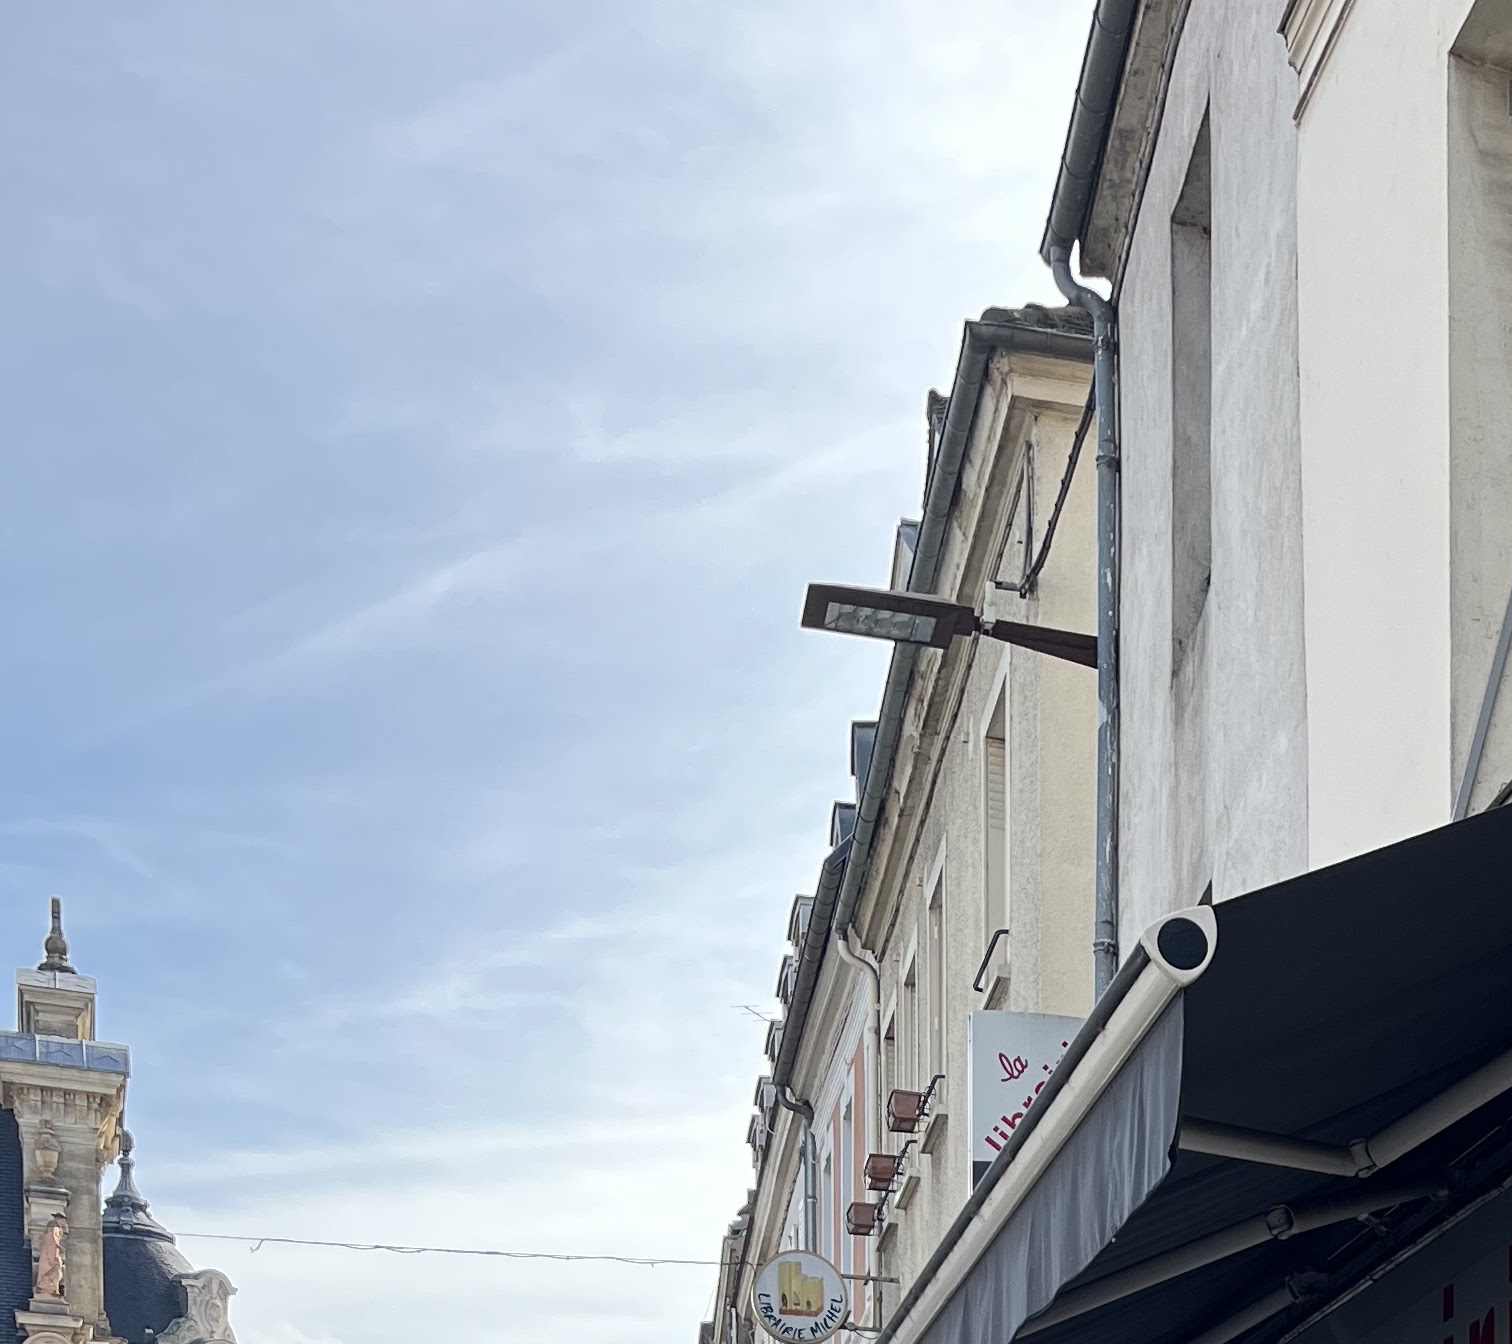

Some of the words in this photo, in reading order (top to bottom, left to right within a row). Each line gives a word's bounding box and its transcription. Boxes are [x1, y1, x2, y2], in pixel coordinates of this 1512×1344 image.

[998, 1052, 1029, 1082] la
[758, 1293, 806, 1341] LIBRAIRIE
[810, 1294, 844, 1339] MICHEL
